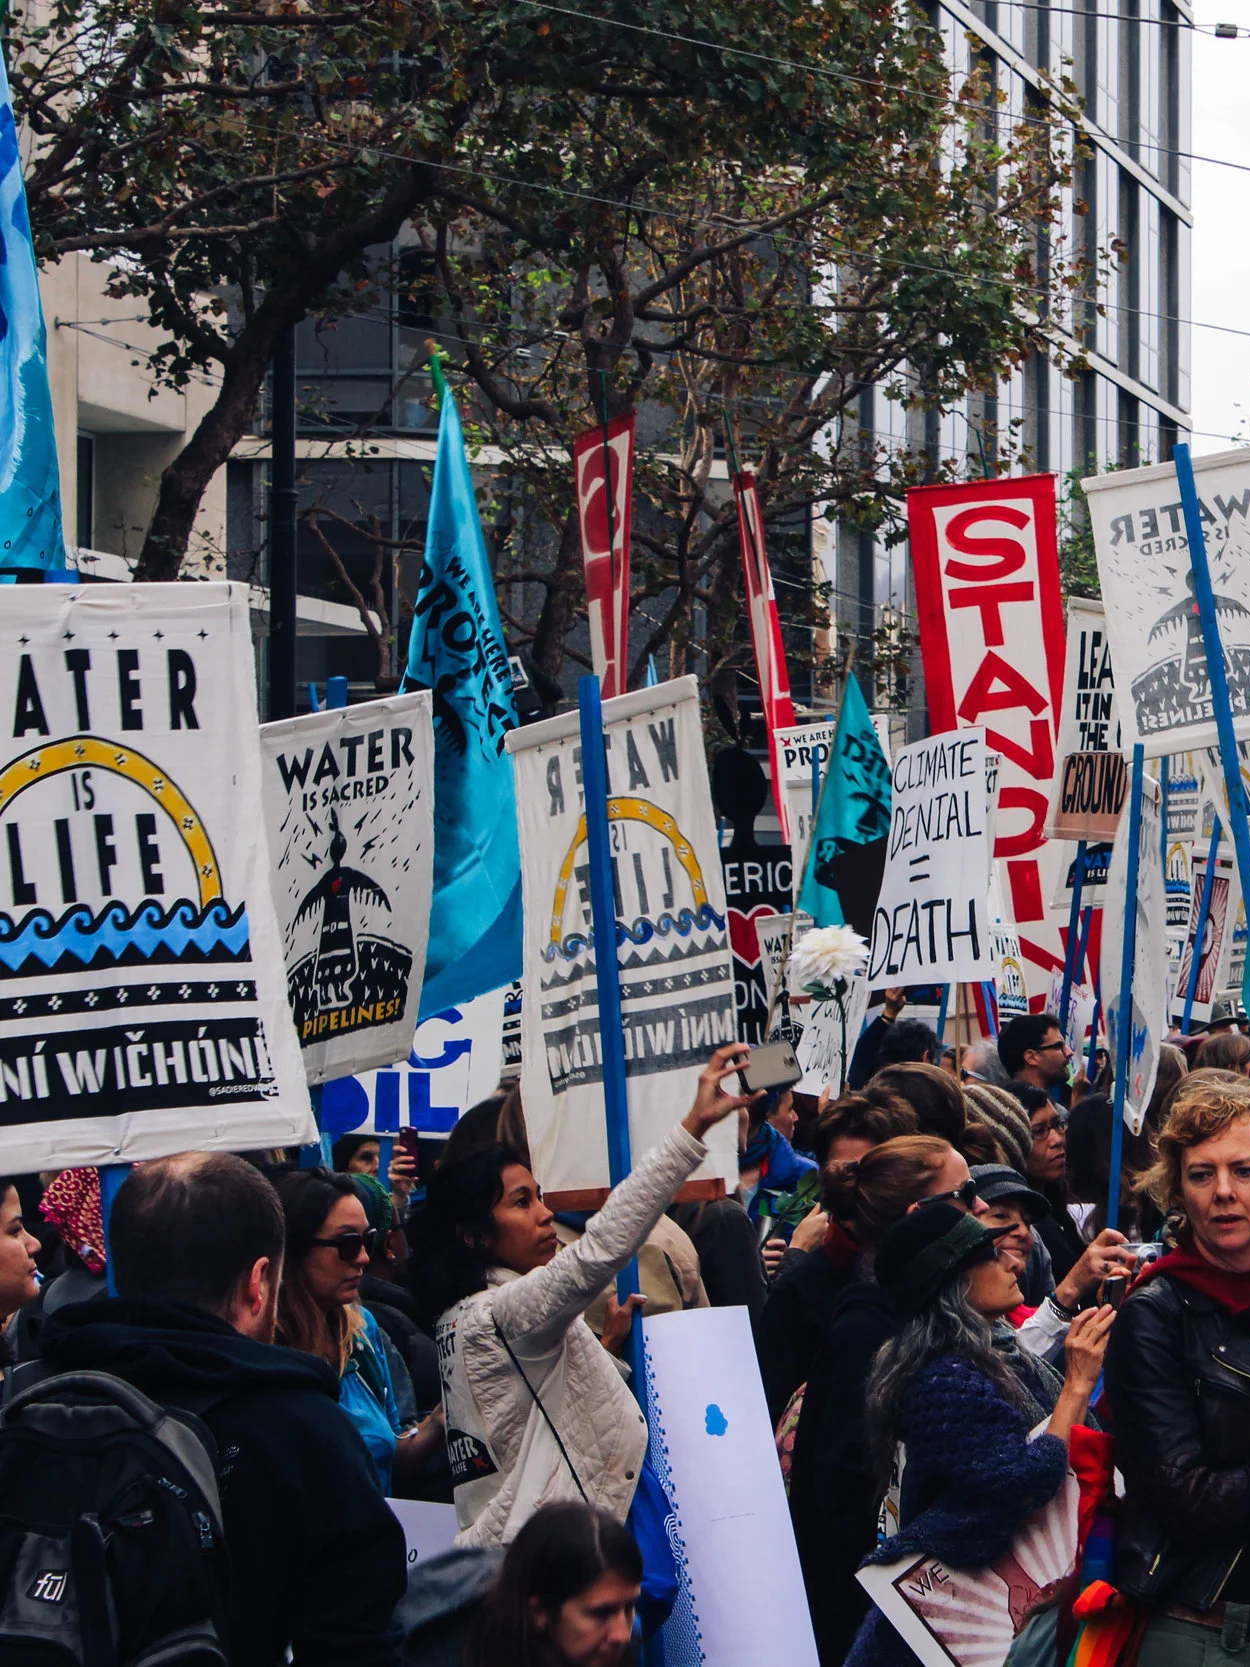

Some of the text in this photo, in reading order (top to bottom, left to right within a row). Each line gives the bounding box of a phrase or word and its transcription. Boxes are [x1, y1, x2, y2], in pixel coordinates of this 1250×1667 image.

[1078, 630, 1115, 690] LEA
[13, 648, 201, 737] ATER
[1076, 693, 1112, 720] IT IN
[276, 727, 416, 795] WATER
[894, 738, 979, 793] CLIMATE
[1079, 721, 1109, 751] THE
[71, 770, 96, 812] IS
[303, 775, 390, 812] IS SACRED
[944, 504, 1103, 1037] STANDIN
[1061, 752, 1128, 814] GROUND
[890, 790, 983, 861] DENIAL
[6, 813, 165, 906] LIFE
[868, 897, 981, 982] DEATH
[303, 997, 401, 1039] PIPELINES!
[0, 1040, 50, 1101] NÍ
[449, 1436, 479, 1466] ATER
[909, 1562, 950, 1597] WE
